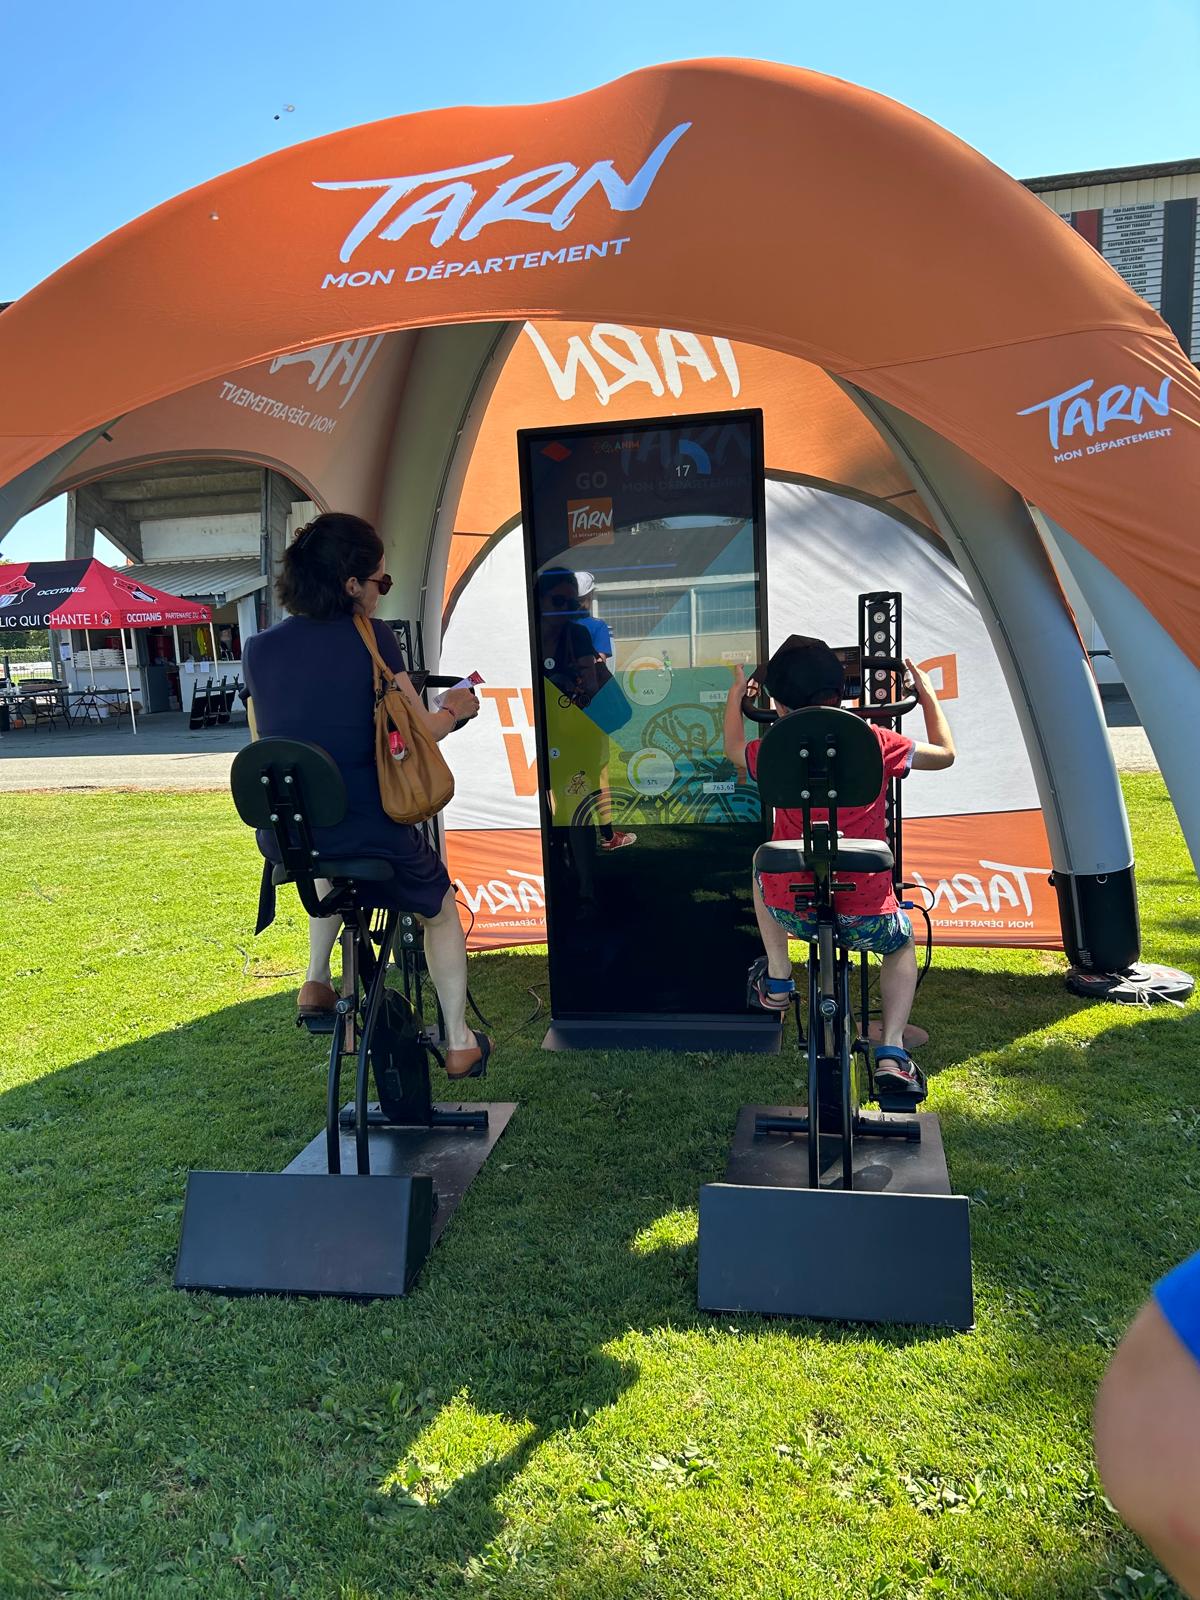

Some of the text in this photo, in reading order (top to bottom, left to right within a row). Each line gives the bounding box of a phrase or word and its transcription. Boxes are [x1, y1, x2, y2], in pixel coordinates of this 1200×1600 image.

[311, 122, 693, 263] TARN
[321, 237, 631, 289] MON DÉPARTEMENT
[1016, 376, 1172, 450] TARN
[1053, 428, 1172, 463] MON DÉPARTEMENT
[576, 471, 608, 491] GO
[675, 464, 691, 478] 17
[568, 505, 613, 533] TARN
[37, 586, 87, 596] OCCITANIS
[20, 615, 40, 626] QUI
[43, 613, 92, 625] CHANTE
[95, 613, 98, 624] !
[126, 612, 162, 623] OCCITANIS
